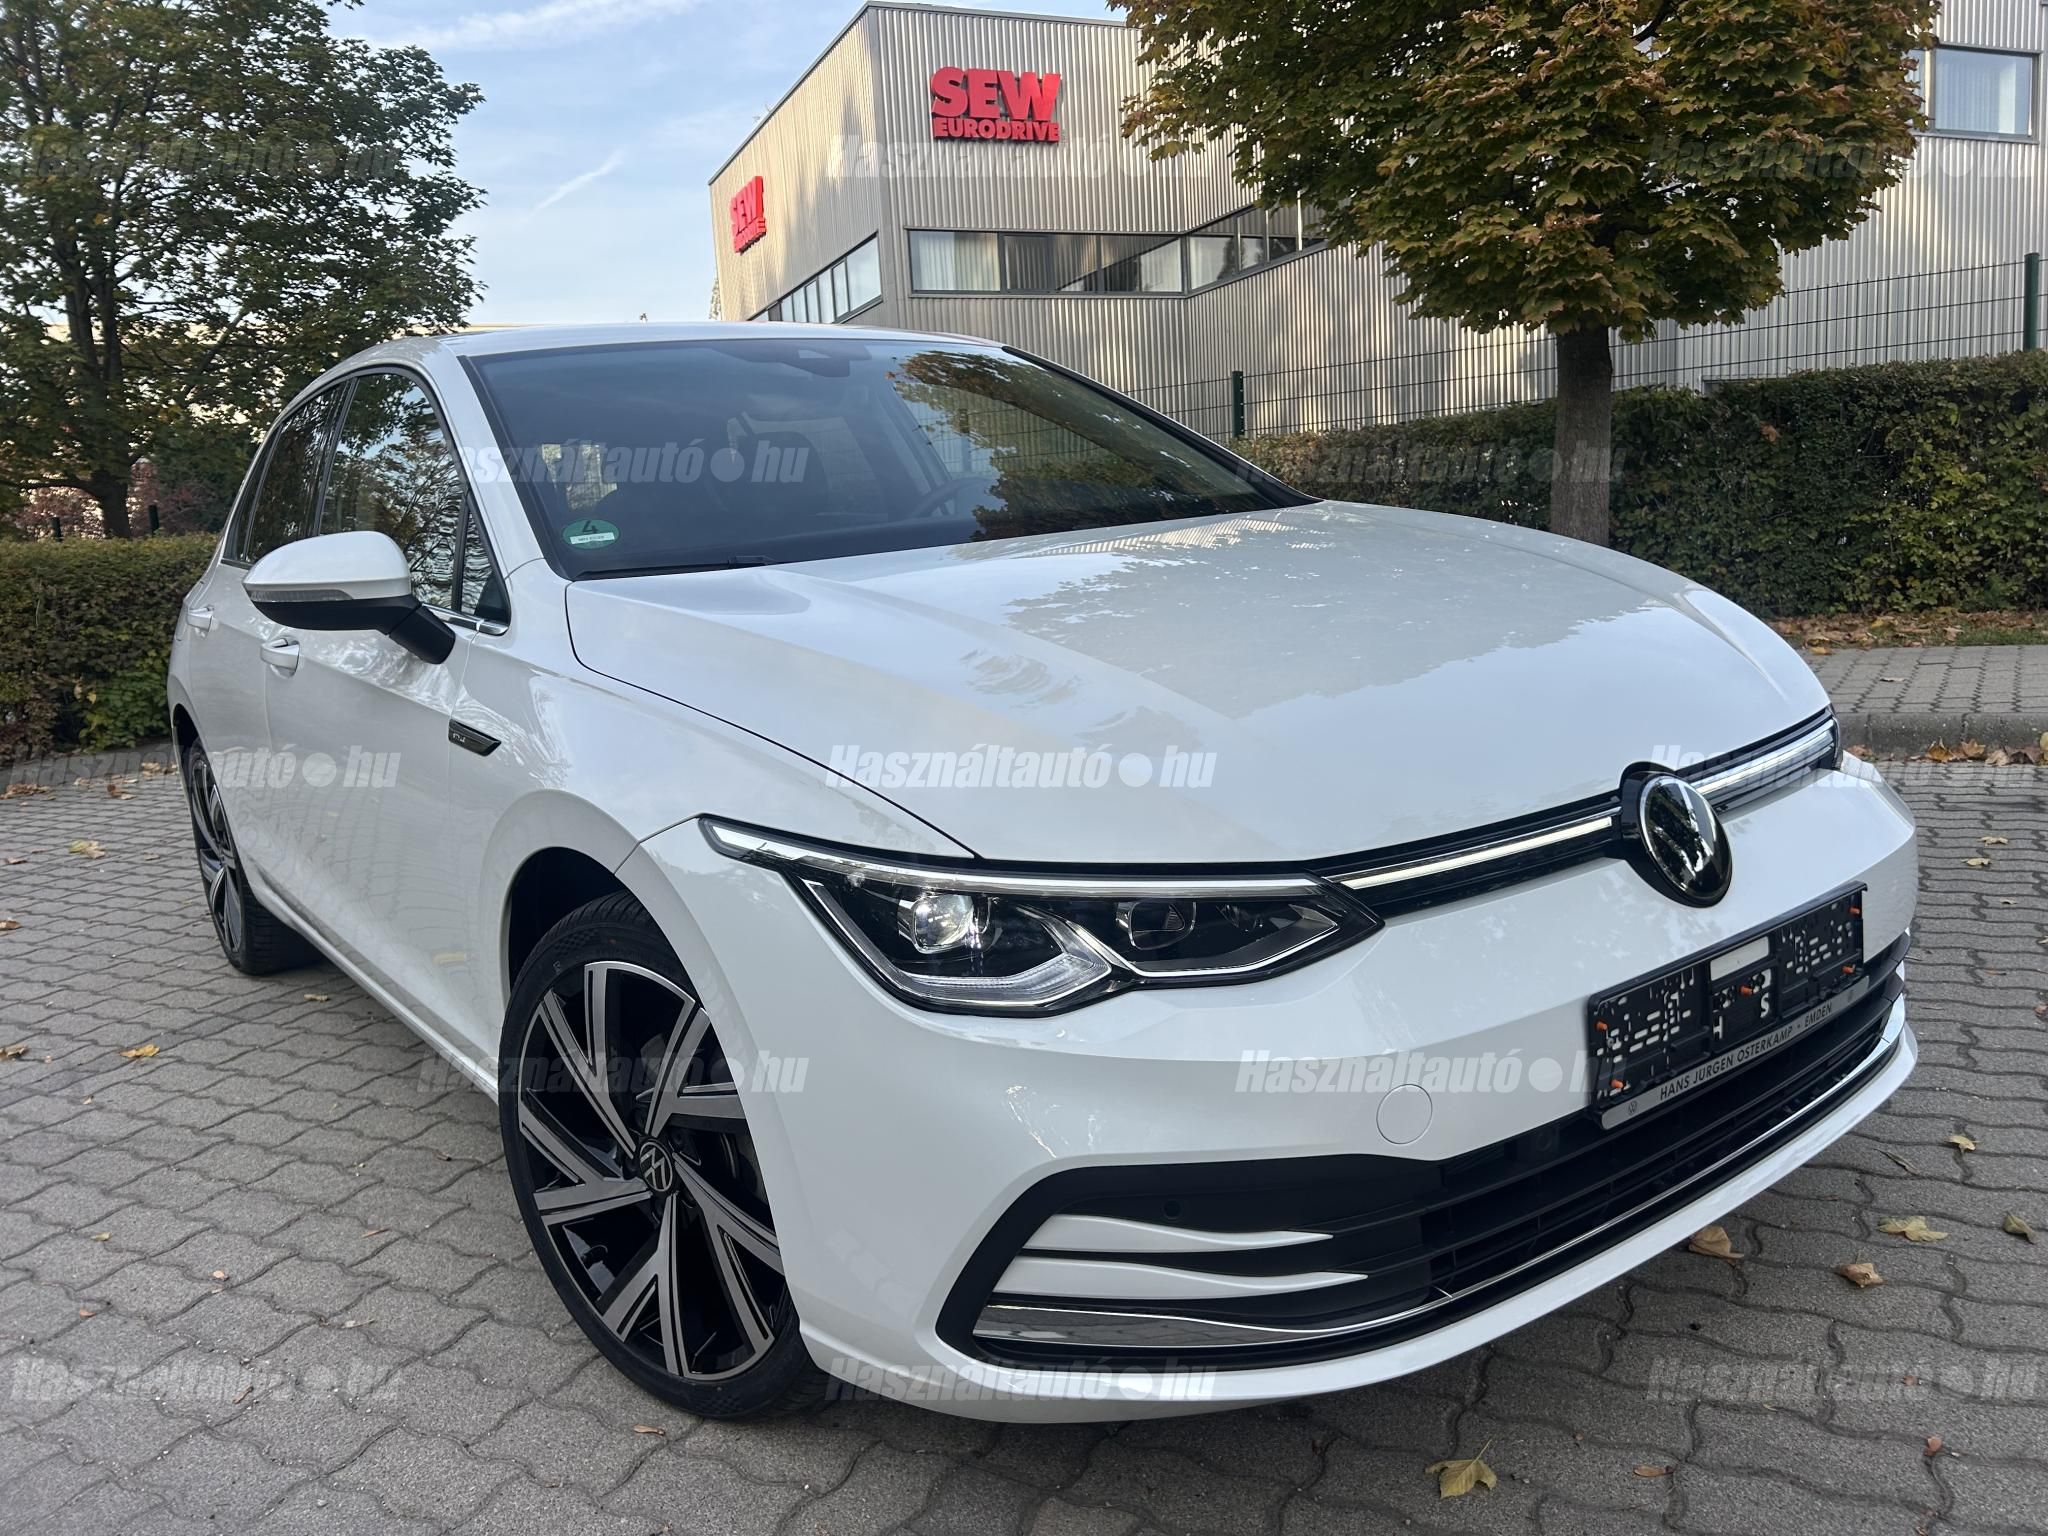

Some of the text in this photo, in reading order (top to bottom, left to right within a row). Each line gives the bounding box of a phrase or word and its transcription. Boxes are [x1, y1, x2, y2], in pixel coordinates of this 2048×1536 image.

[931, 66, 1061, 121] SEW
[933, 117, 1060, 142] EURODRIVE
[1660, 1074, 1690, 1100] HANS
[1737, 1026, 1793, 1062] OSTERKAMP
[1804, 1003, 1832, 1027] EMDEN
